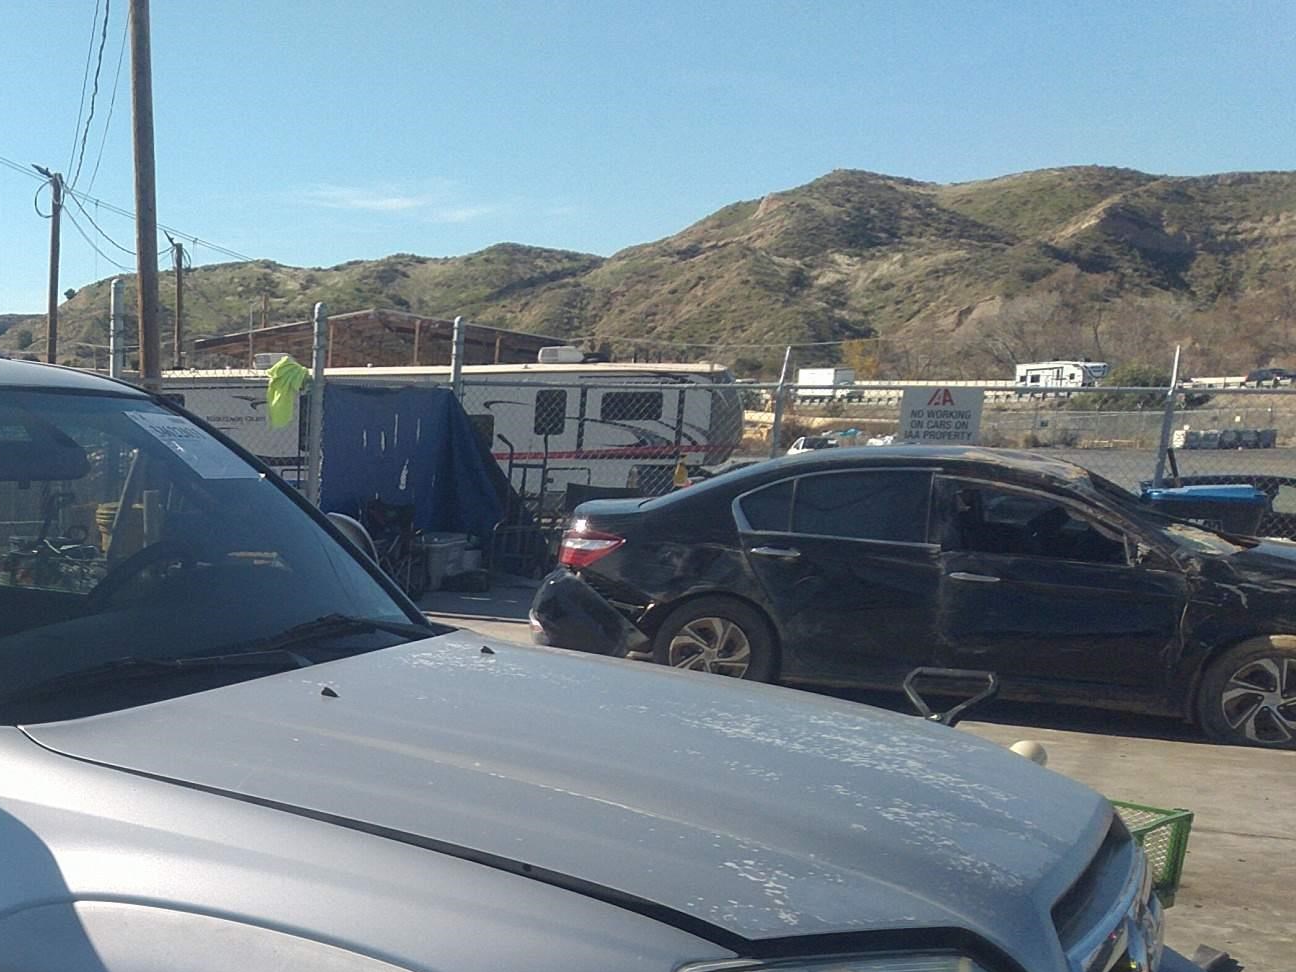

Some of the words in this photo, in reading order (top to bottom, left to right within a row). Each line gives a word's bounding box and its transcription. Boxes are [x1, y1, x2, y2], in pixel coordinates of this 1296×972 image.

[910, 409, 924, 419] NO
[927, 409, 972, 420] WORKING
[910, 420, 924, 429] ON
[926, 420, 953, 430] CARS
[955, 420, 969, 430] ON
[904, 430, 921, 440] IAA
[922, 430, 973, 441] PROPERTY
